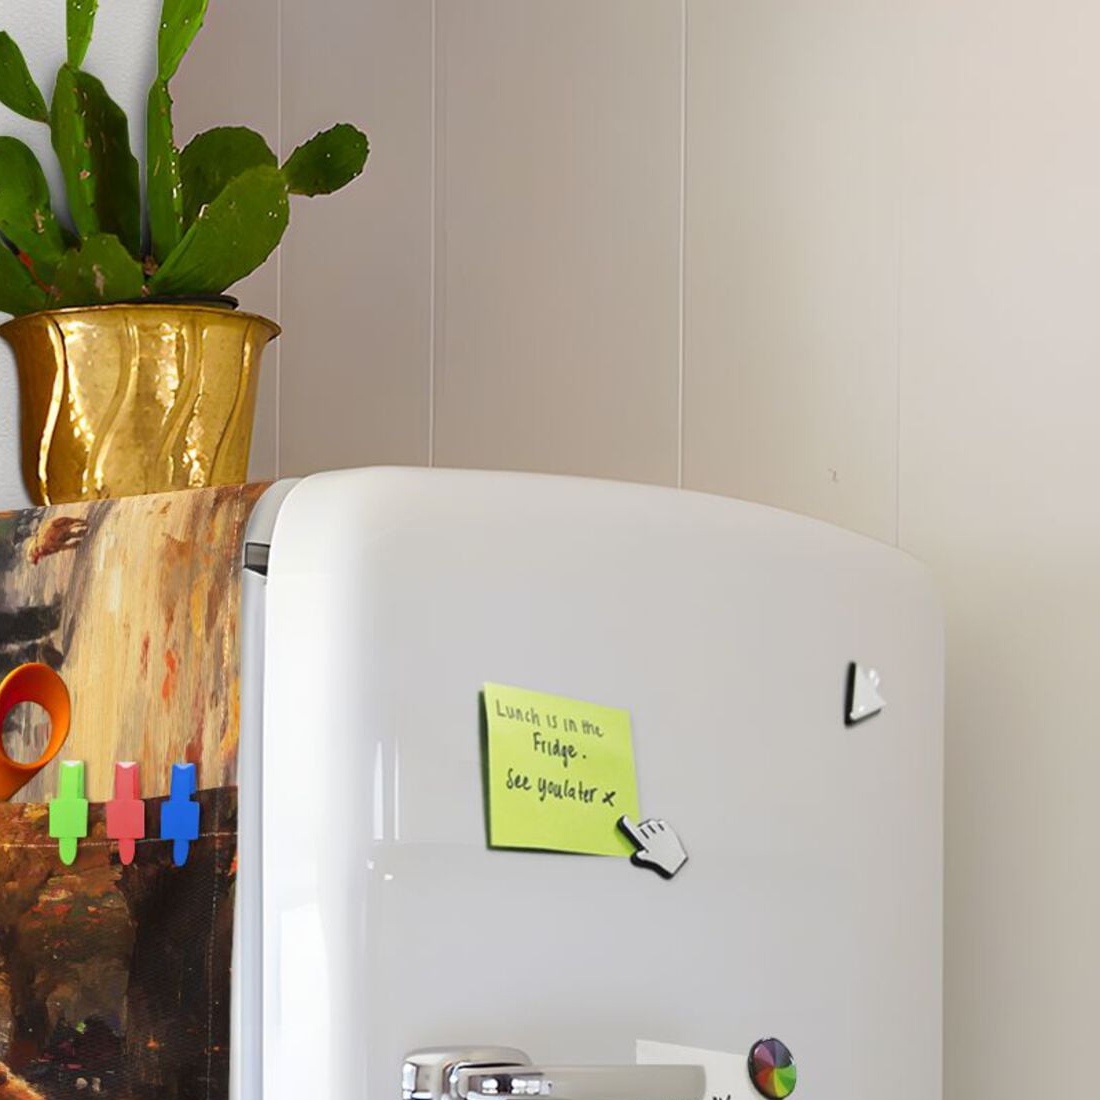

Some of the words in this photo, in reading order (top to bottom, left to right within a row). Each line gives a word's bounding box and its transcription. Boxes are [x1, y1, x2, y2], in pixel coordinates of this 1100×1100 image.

[495, 699, 541, 727] Lunch
[563, 718, 578, 732] in
[581, 720, 604, 737] the
[506, 768, 532, 791] See
